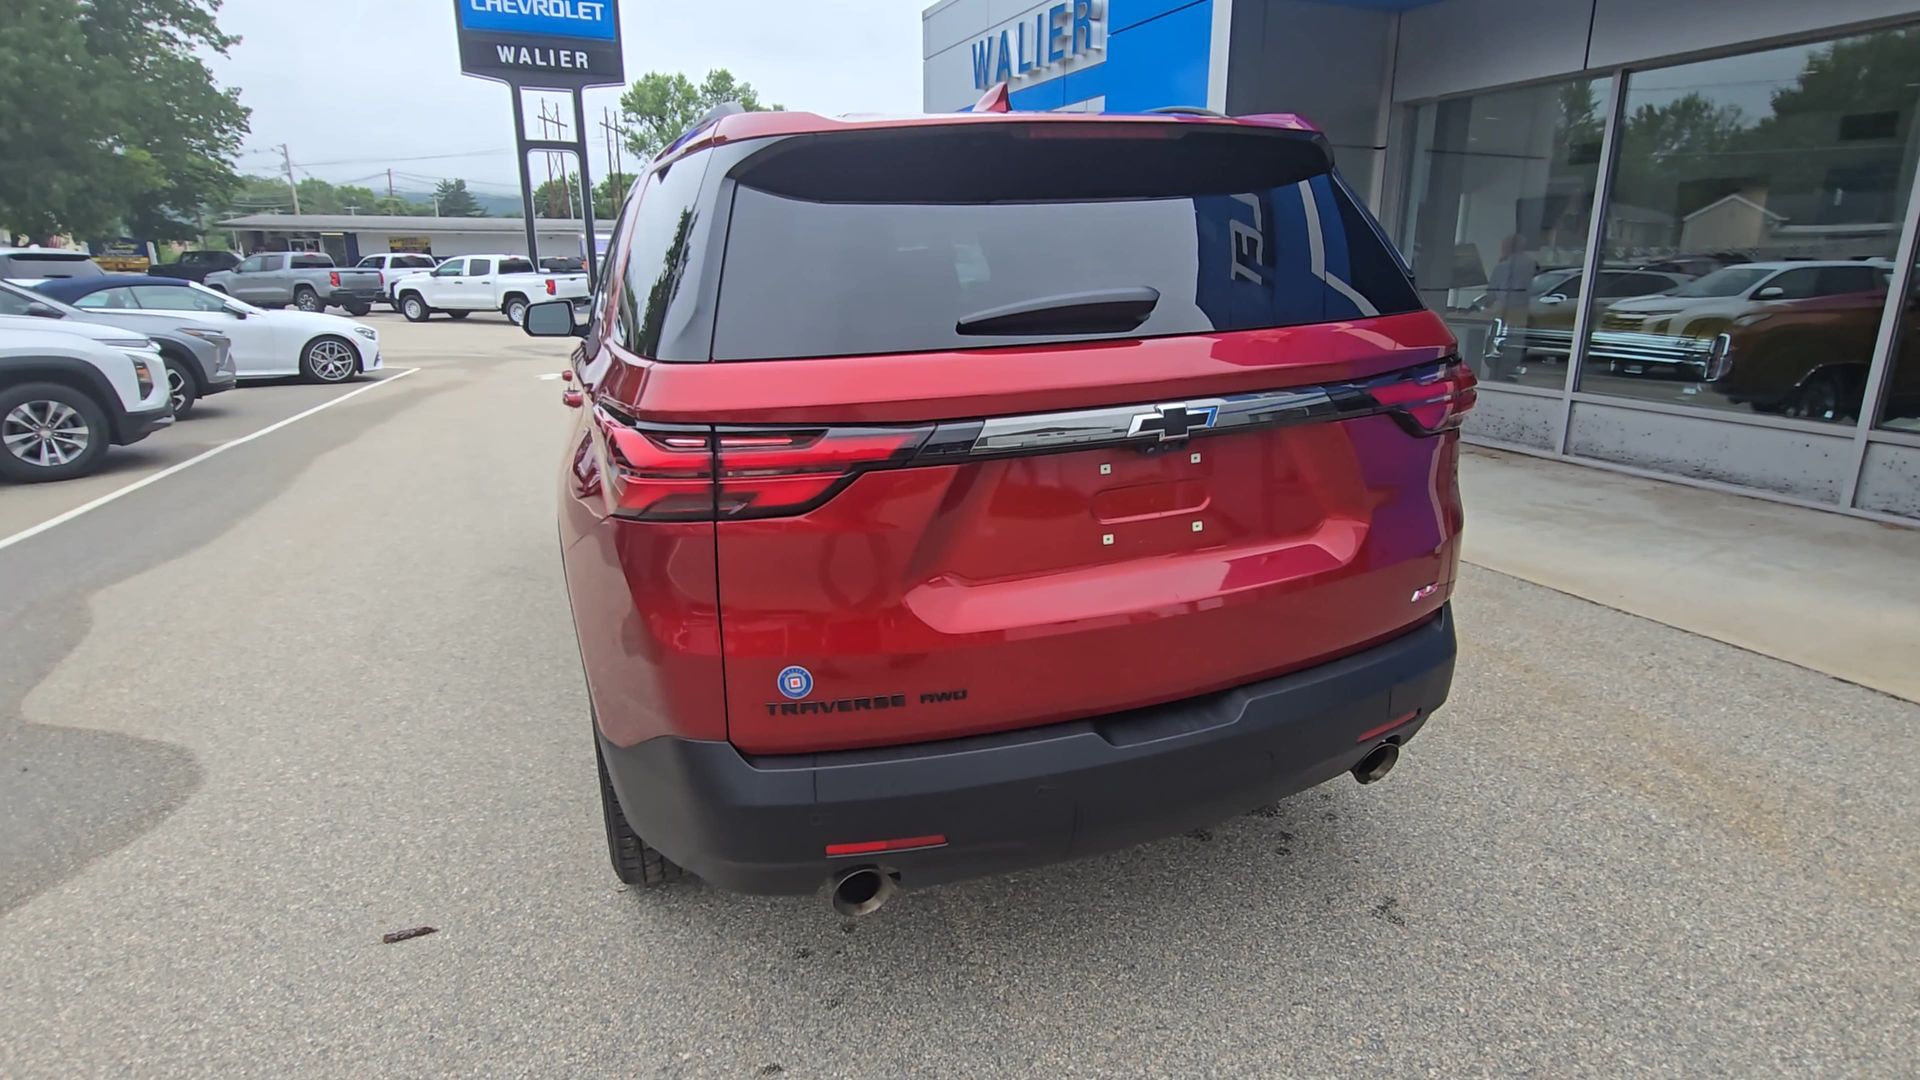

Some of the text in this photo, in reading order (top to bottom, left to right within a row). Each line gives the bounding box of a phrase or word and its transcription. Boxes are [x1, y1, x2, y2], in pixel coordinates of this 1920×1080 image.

[471, 0, 604, 21] CHEVROLET
[496, 45, 589, 69] WALIER
[972, 0, 1096, 90] WALIER
[765, 689, 968, 716] TRAVERSE AWD
